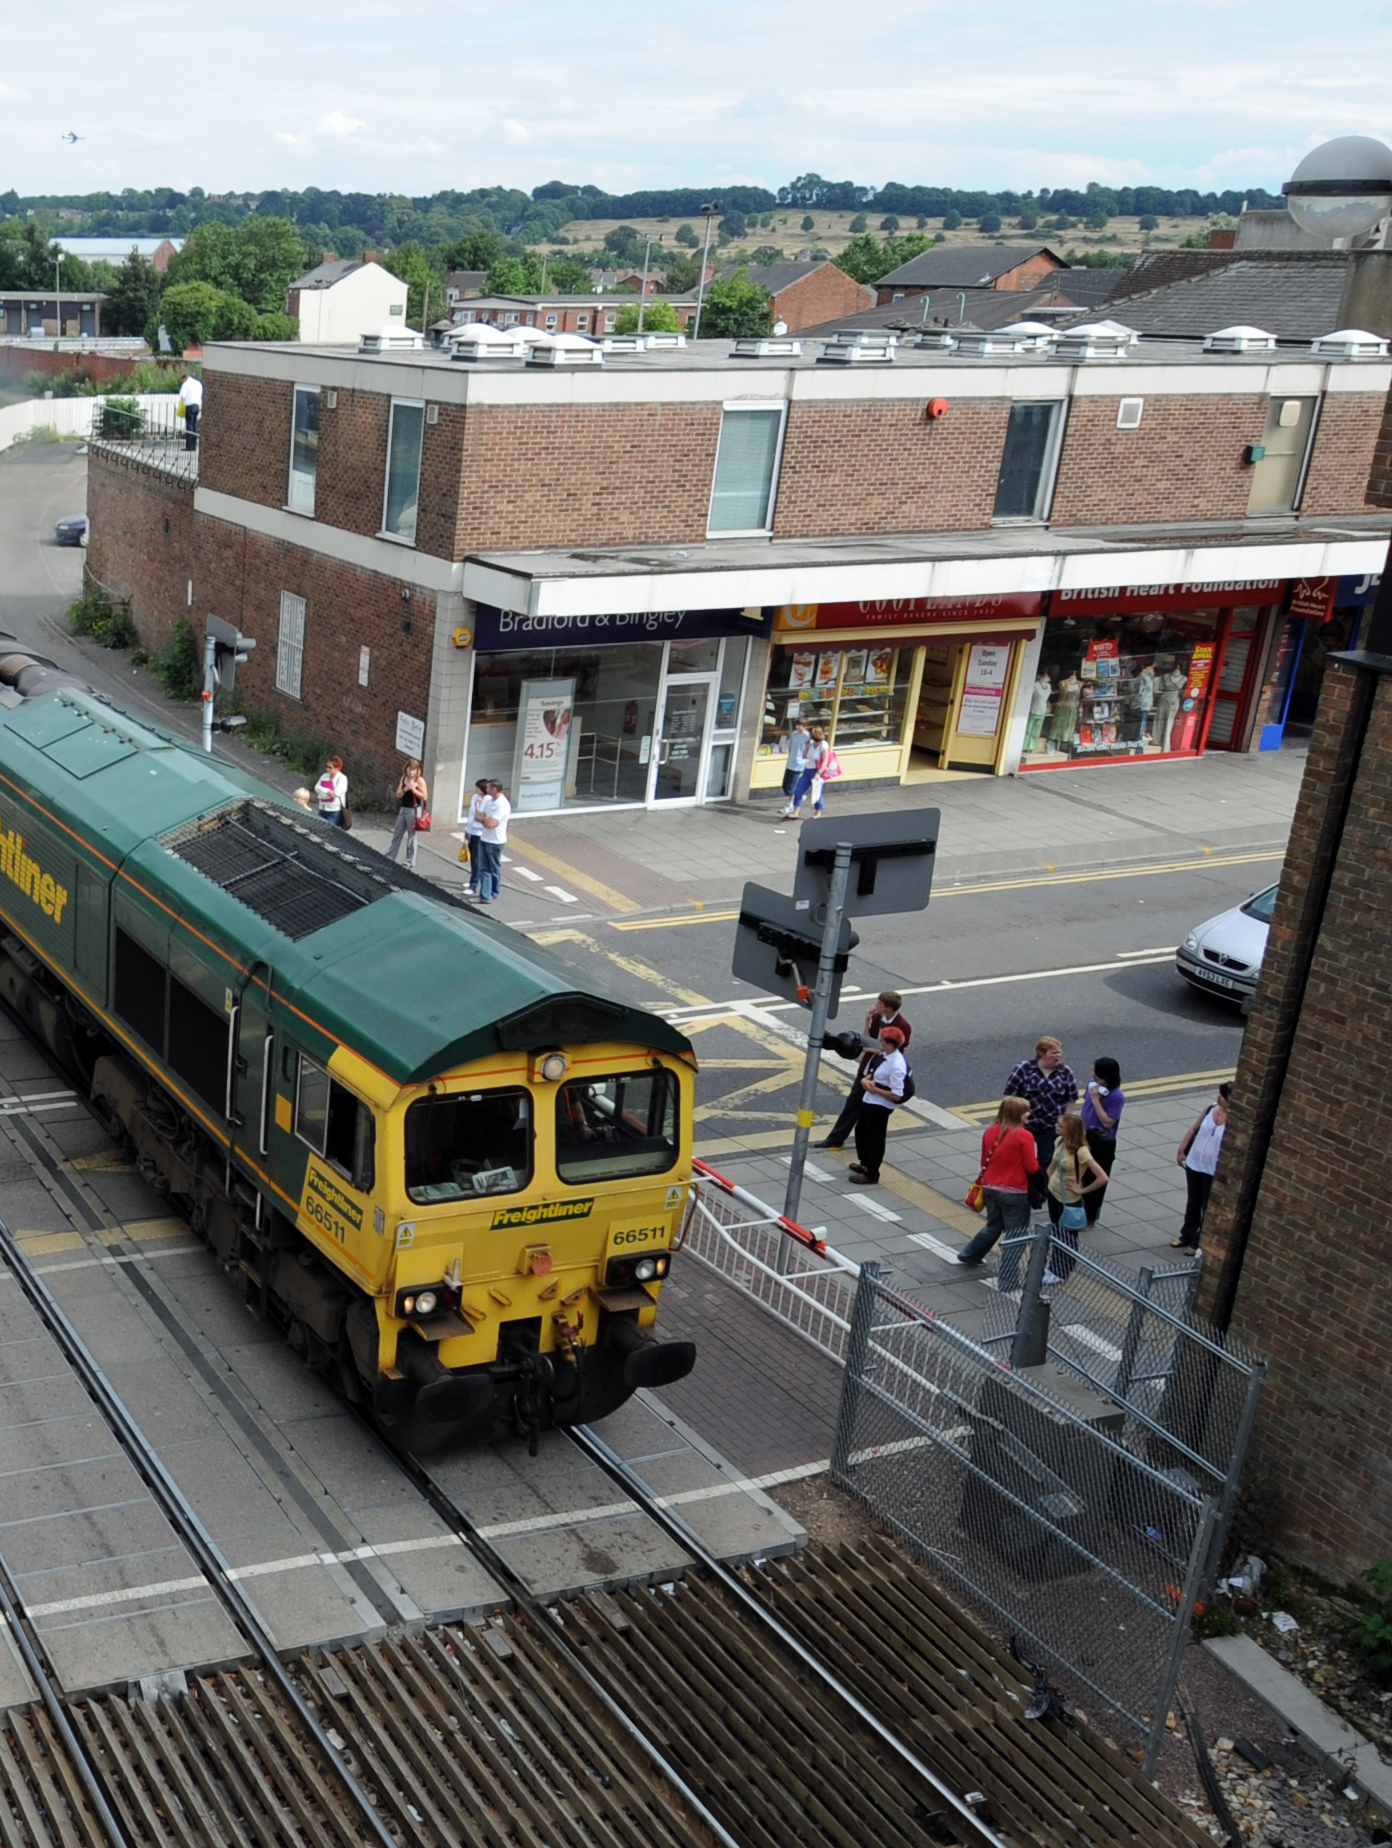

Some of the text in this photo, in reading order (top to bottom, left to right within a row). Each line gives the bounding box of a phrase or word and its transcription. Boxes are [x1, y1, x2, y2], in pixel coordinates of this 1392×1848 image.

[309, 1169, 363, 1224] Freightliner
[493, 1201, 593, 1225] Freightliner
[306, 1195, 346, 1245] 66511
[613, 1226, 666, 1246] 66511
